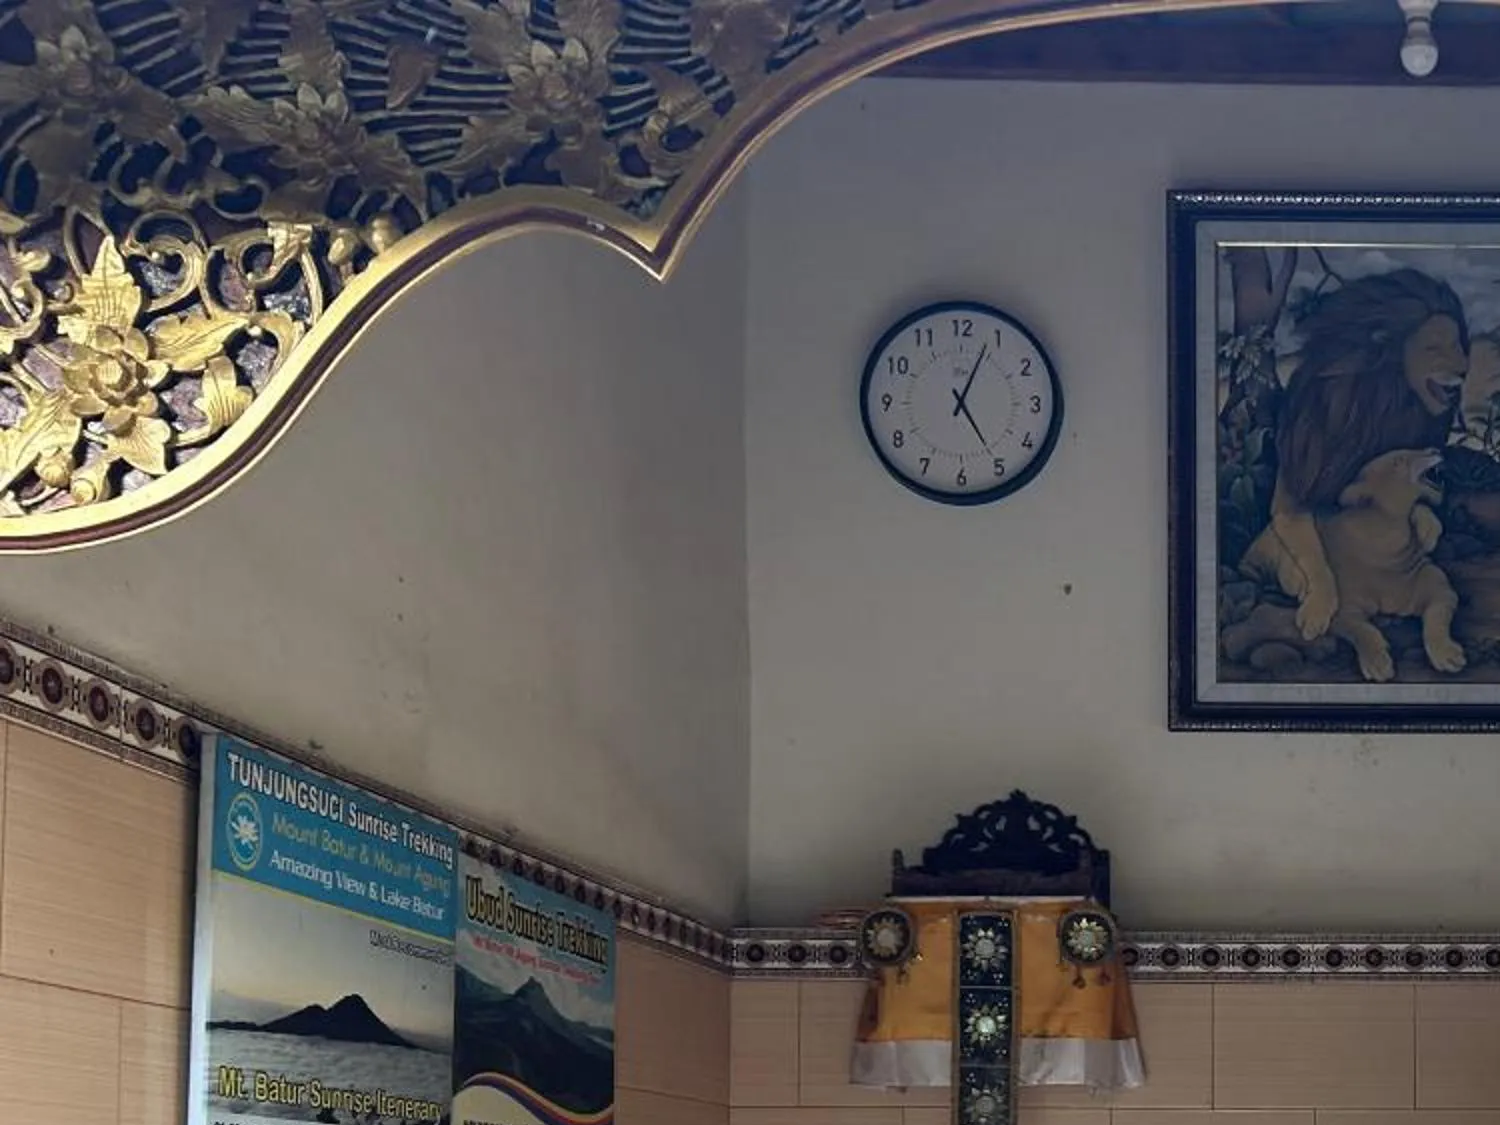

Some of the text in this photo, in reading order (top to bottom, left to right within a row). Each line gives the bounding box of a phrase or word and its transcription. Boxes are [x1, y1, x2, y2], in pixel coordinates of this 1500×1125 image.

[914, 328, 933, 347] 11
[952, 319, 973, 337] 12
[994, 330, 1002, 348] 1
[888, 356, 909, 375] 10
[1020, 358, 1032, 377] 2
[881, 393, 893, 412] 9
[1029, 395, 1041, 413] 3
[892, 429, 904, 448] 8
[1021, 431, 1033, 449] 4
[919, 457, 931, 476] 7
[993, 458, 1005, 477] 5
[956, 466, 967, 487] 6
[227, 752, 453, 870] TUNJUNGSUCI Sunrise Trekking
[272, 811, 318, 847] Mount
[269, 849, 333, 889] Amazing
[335, 870, 365, 897] View
[368, 880, 378, 901] &
[381, 885, 409, 911] Lake
[466, 874, 505, 930] Ubud
[506, 891, 555, 947] Sunrise
[218, 1065, 248, 1099] Mt.
[255, 1070, 305, 1105] Batur
[310, 1078, 373, 1115] Sunrise
